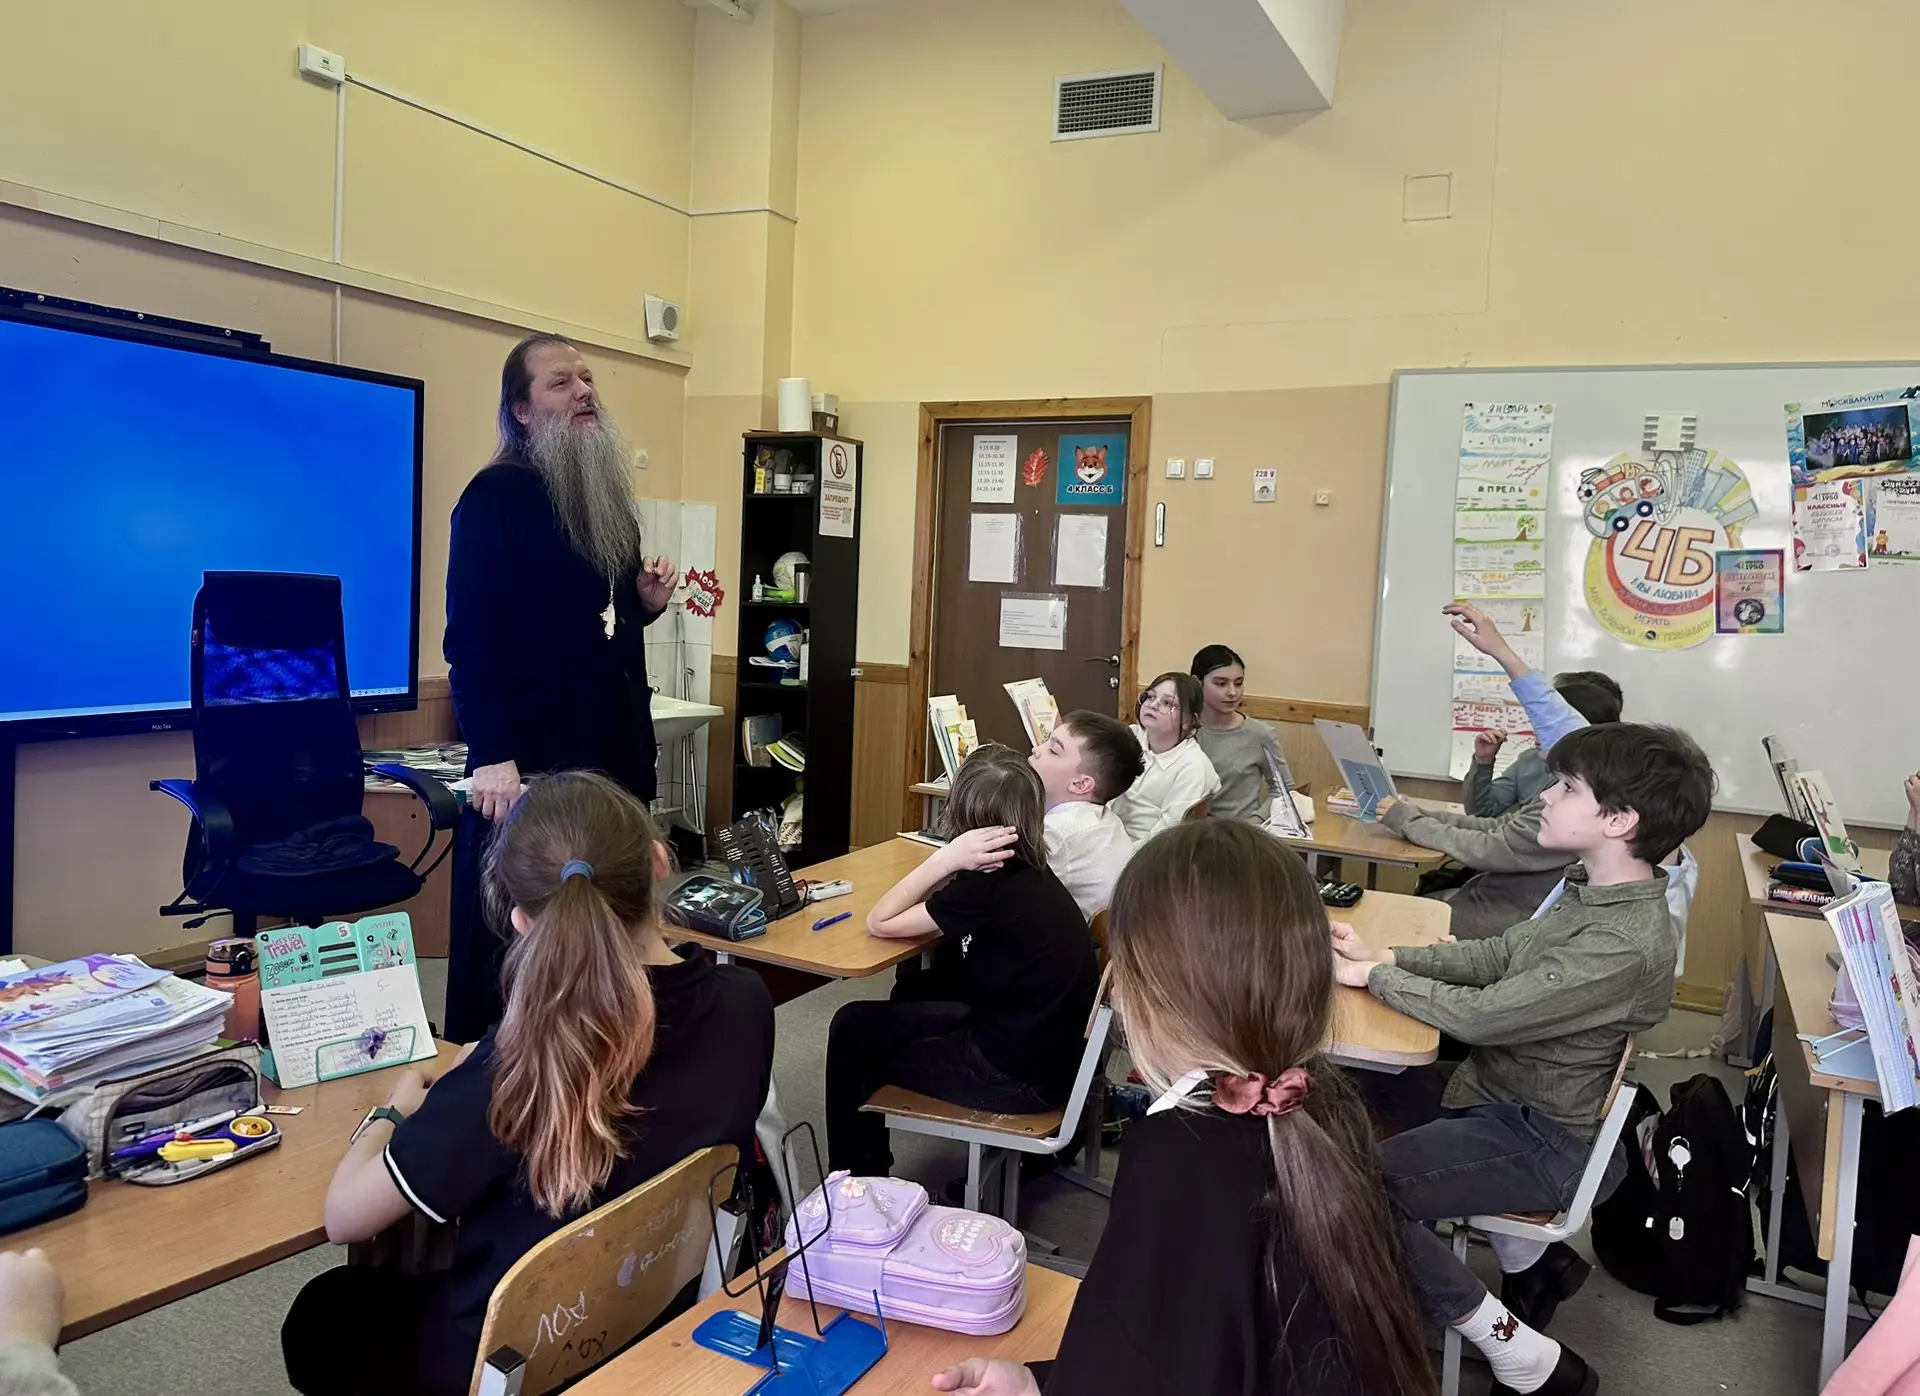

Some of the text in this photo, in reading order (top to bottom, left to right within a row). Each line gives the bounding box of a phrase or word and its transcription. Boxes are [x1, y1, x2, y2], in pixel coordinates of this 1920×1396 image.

[1488, 403, 1529, 414] ЯНВАРЬ
[1067, 484, 1114, 494] 4 КЛАСС Б
[1807, 502, 1847, 511] КЛАССНЫЕ
[1652, 588, 1700, 601] ЛЮБИМ
[1633, 613, 1671, 626] ИГРАТЬ
[263, 933, 307, 960] Travel
